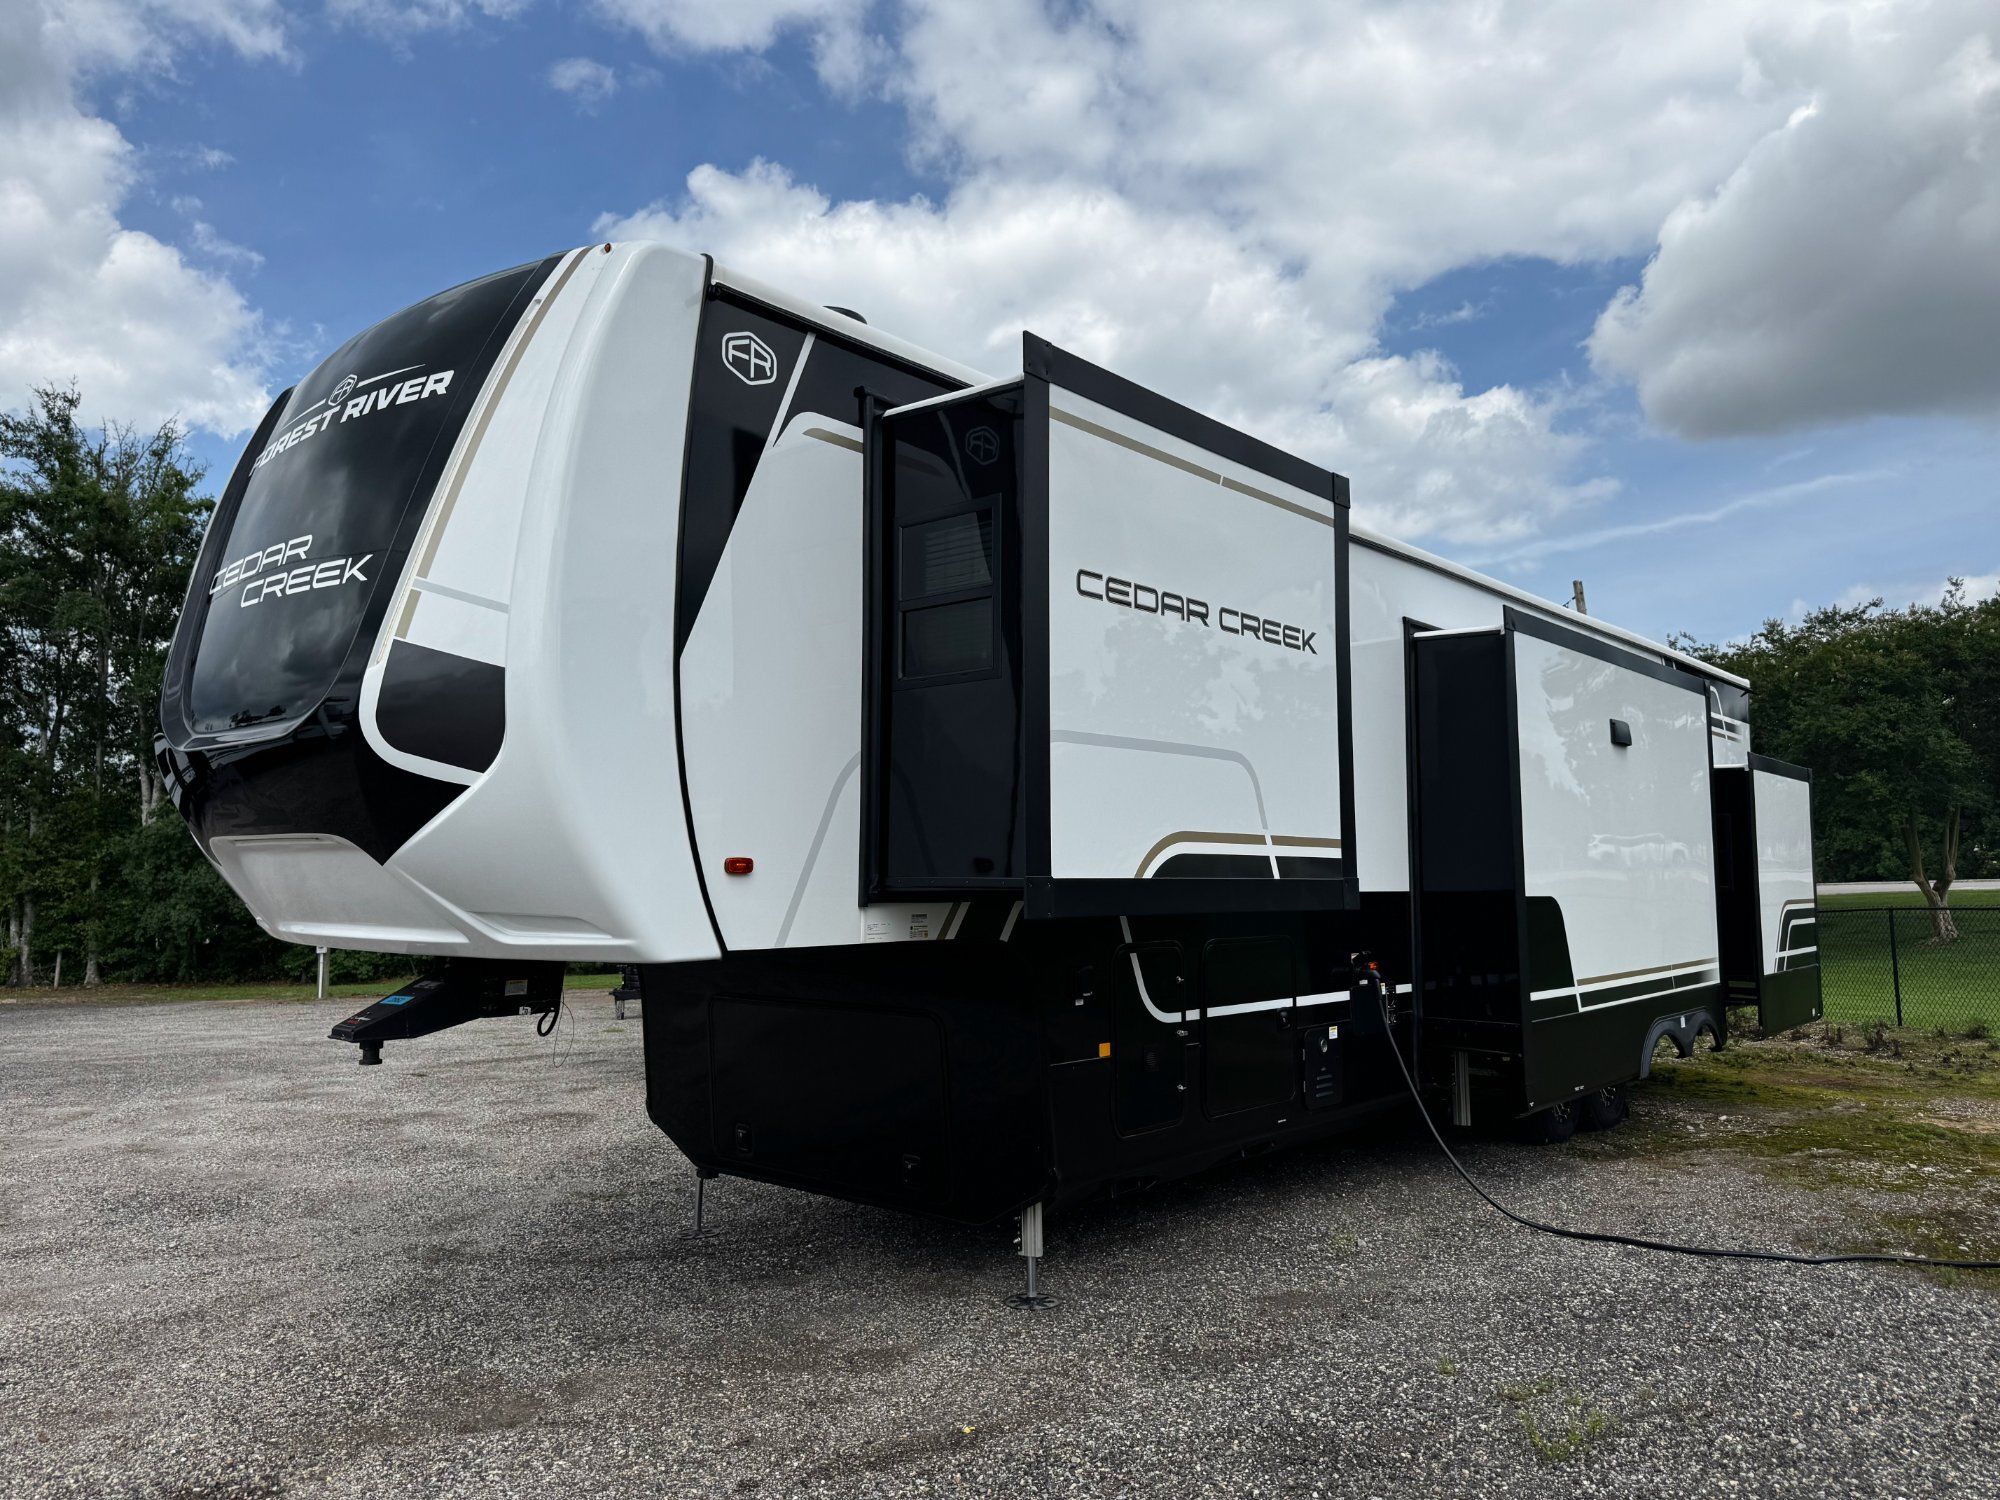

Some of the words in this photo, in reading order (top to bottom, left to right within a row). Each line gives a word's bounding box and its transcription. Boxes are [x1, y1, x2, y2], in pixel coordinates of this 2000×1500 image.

[248, 404, 341, 477] FOREST
[340, 369, 455, 424] RIVER
[208, 534, 313, 595] CEDAR
[240, 553, 374, 608] CREEK
[1076, 568, 1210, 628] CEDAR
[1218, 606, 1318, 655] CREEK
